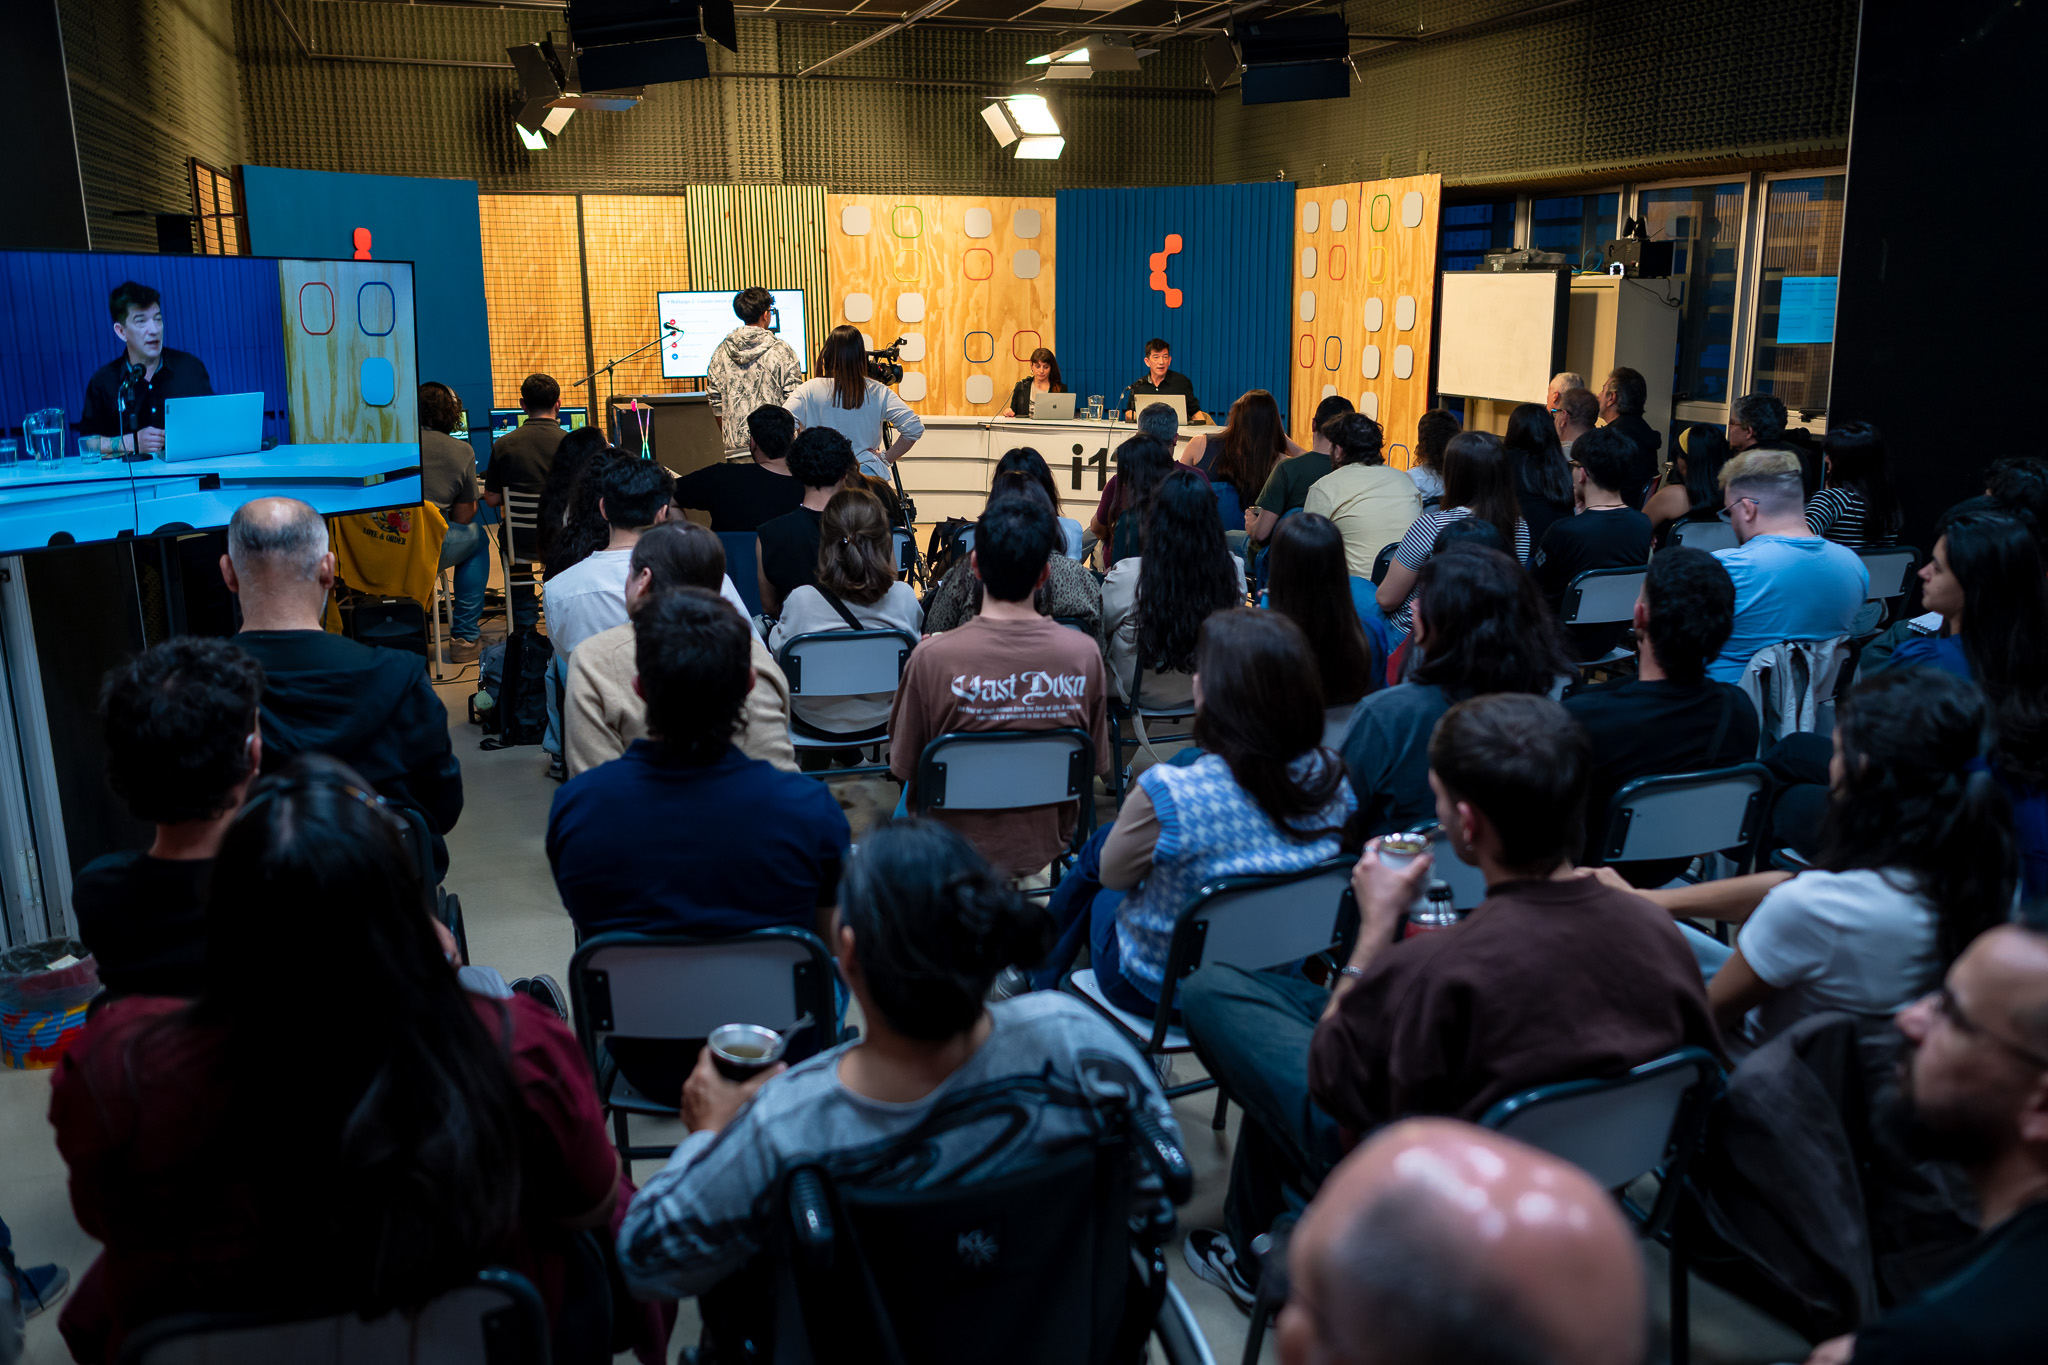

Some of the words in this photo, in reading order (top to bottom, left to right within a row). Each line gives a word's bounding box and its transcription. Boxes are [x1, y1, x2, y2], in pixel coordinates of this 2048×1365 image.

[1072, 443, 1117, 491] i1
[363, 527, 378, 538] LOVE
[386, 534, 406, 545] ORDER
